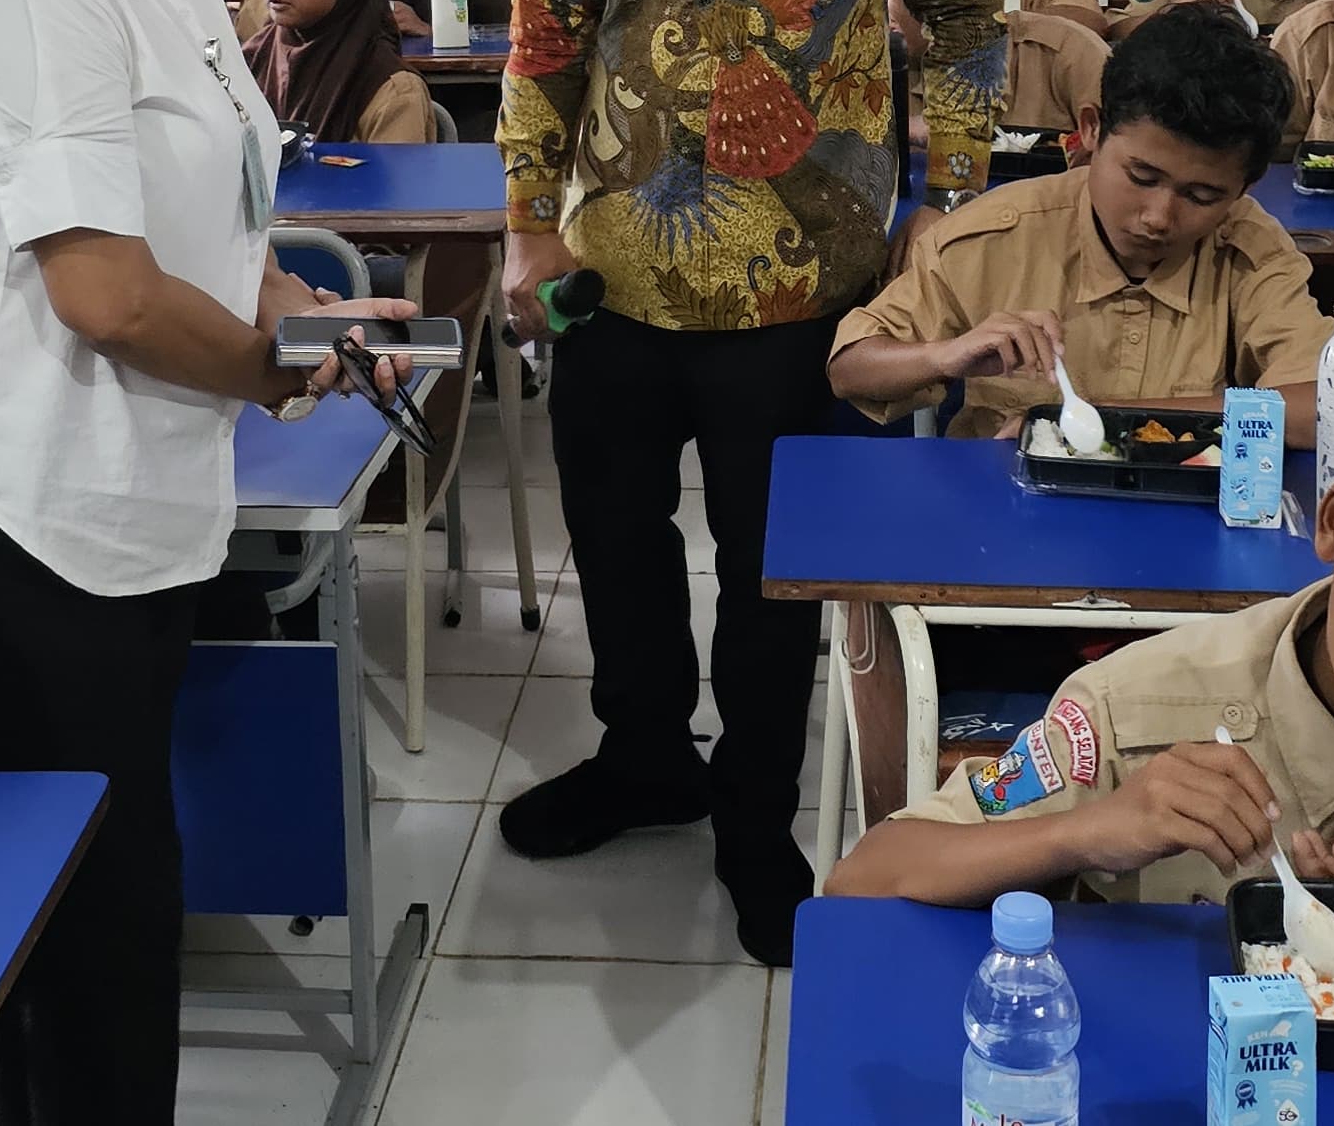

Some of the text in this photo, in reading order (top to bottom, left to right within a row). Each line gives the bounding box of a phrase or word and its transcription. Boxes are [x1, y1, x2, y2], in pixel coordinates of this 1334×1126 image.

[1237, 420, 1273, 430] ULTRA
[1241, 430, 1269, 439] MILK
[1239, 1041, 1298, 1060] ULTRA
[1244, 1056, 1290, 1073] MILK
